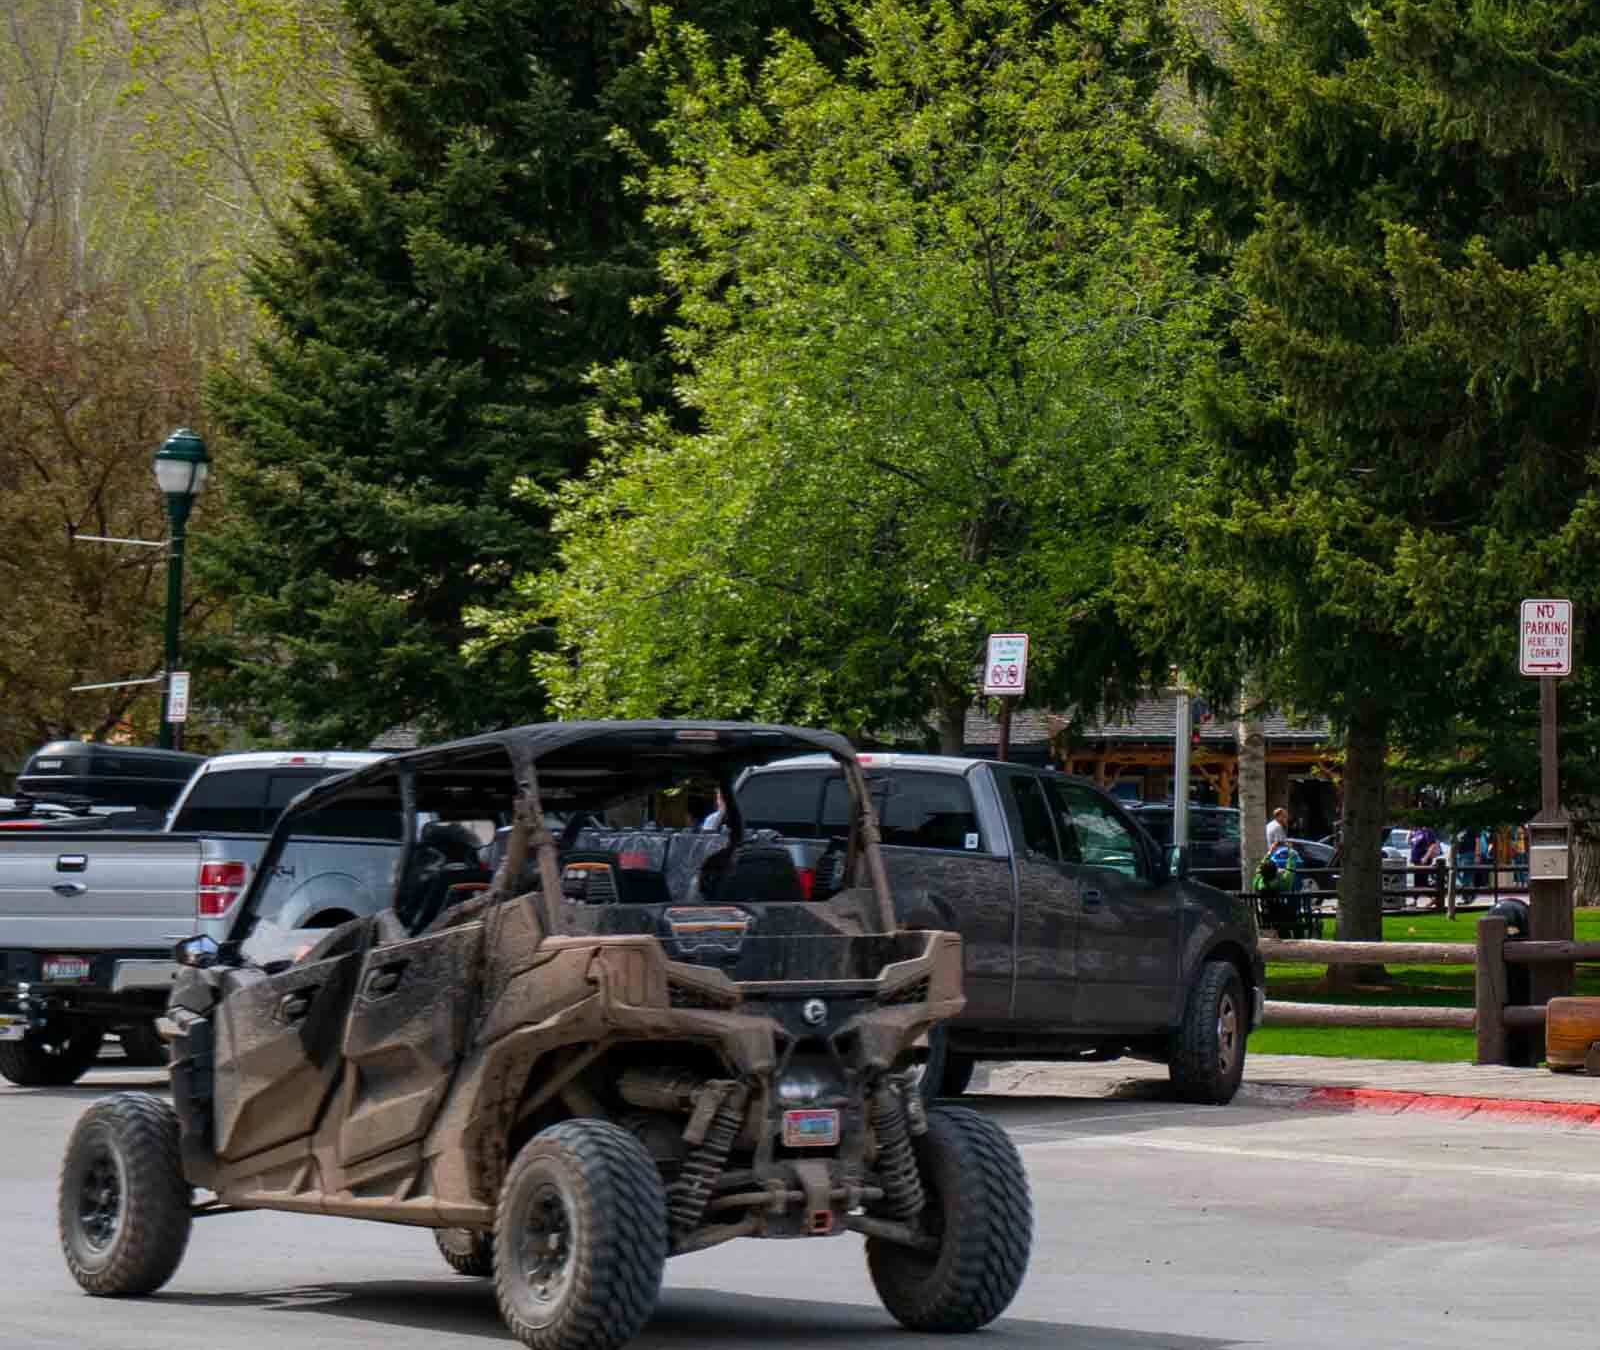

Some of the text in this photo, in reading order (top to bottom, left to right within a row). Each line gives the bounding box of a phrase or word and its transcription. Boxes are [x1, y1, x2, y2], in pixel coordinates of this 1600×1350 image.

[1536, 605, 1555, 619] NO
[1525, 621, 1568, 635] PARKING
[1528, 637, 1564, 647] HERE TO
[1530, 649, 1560, 659] CORNER
